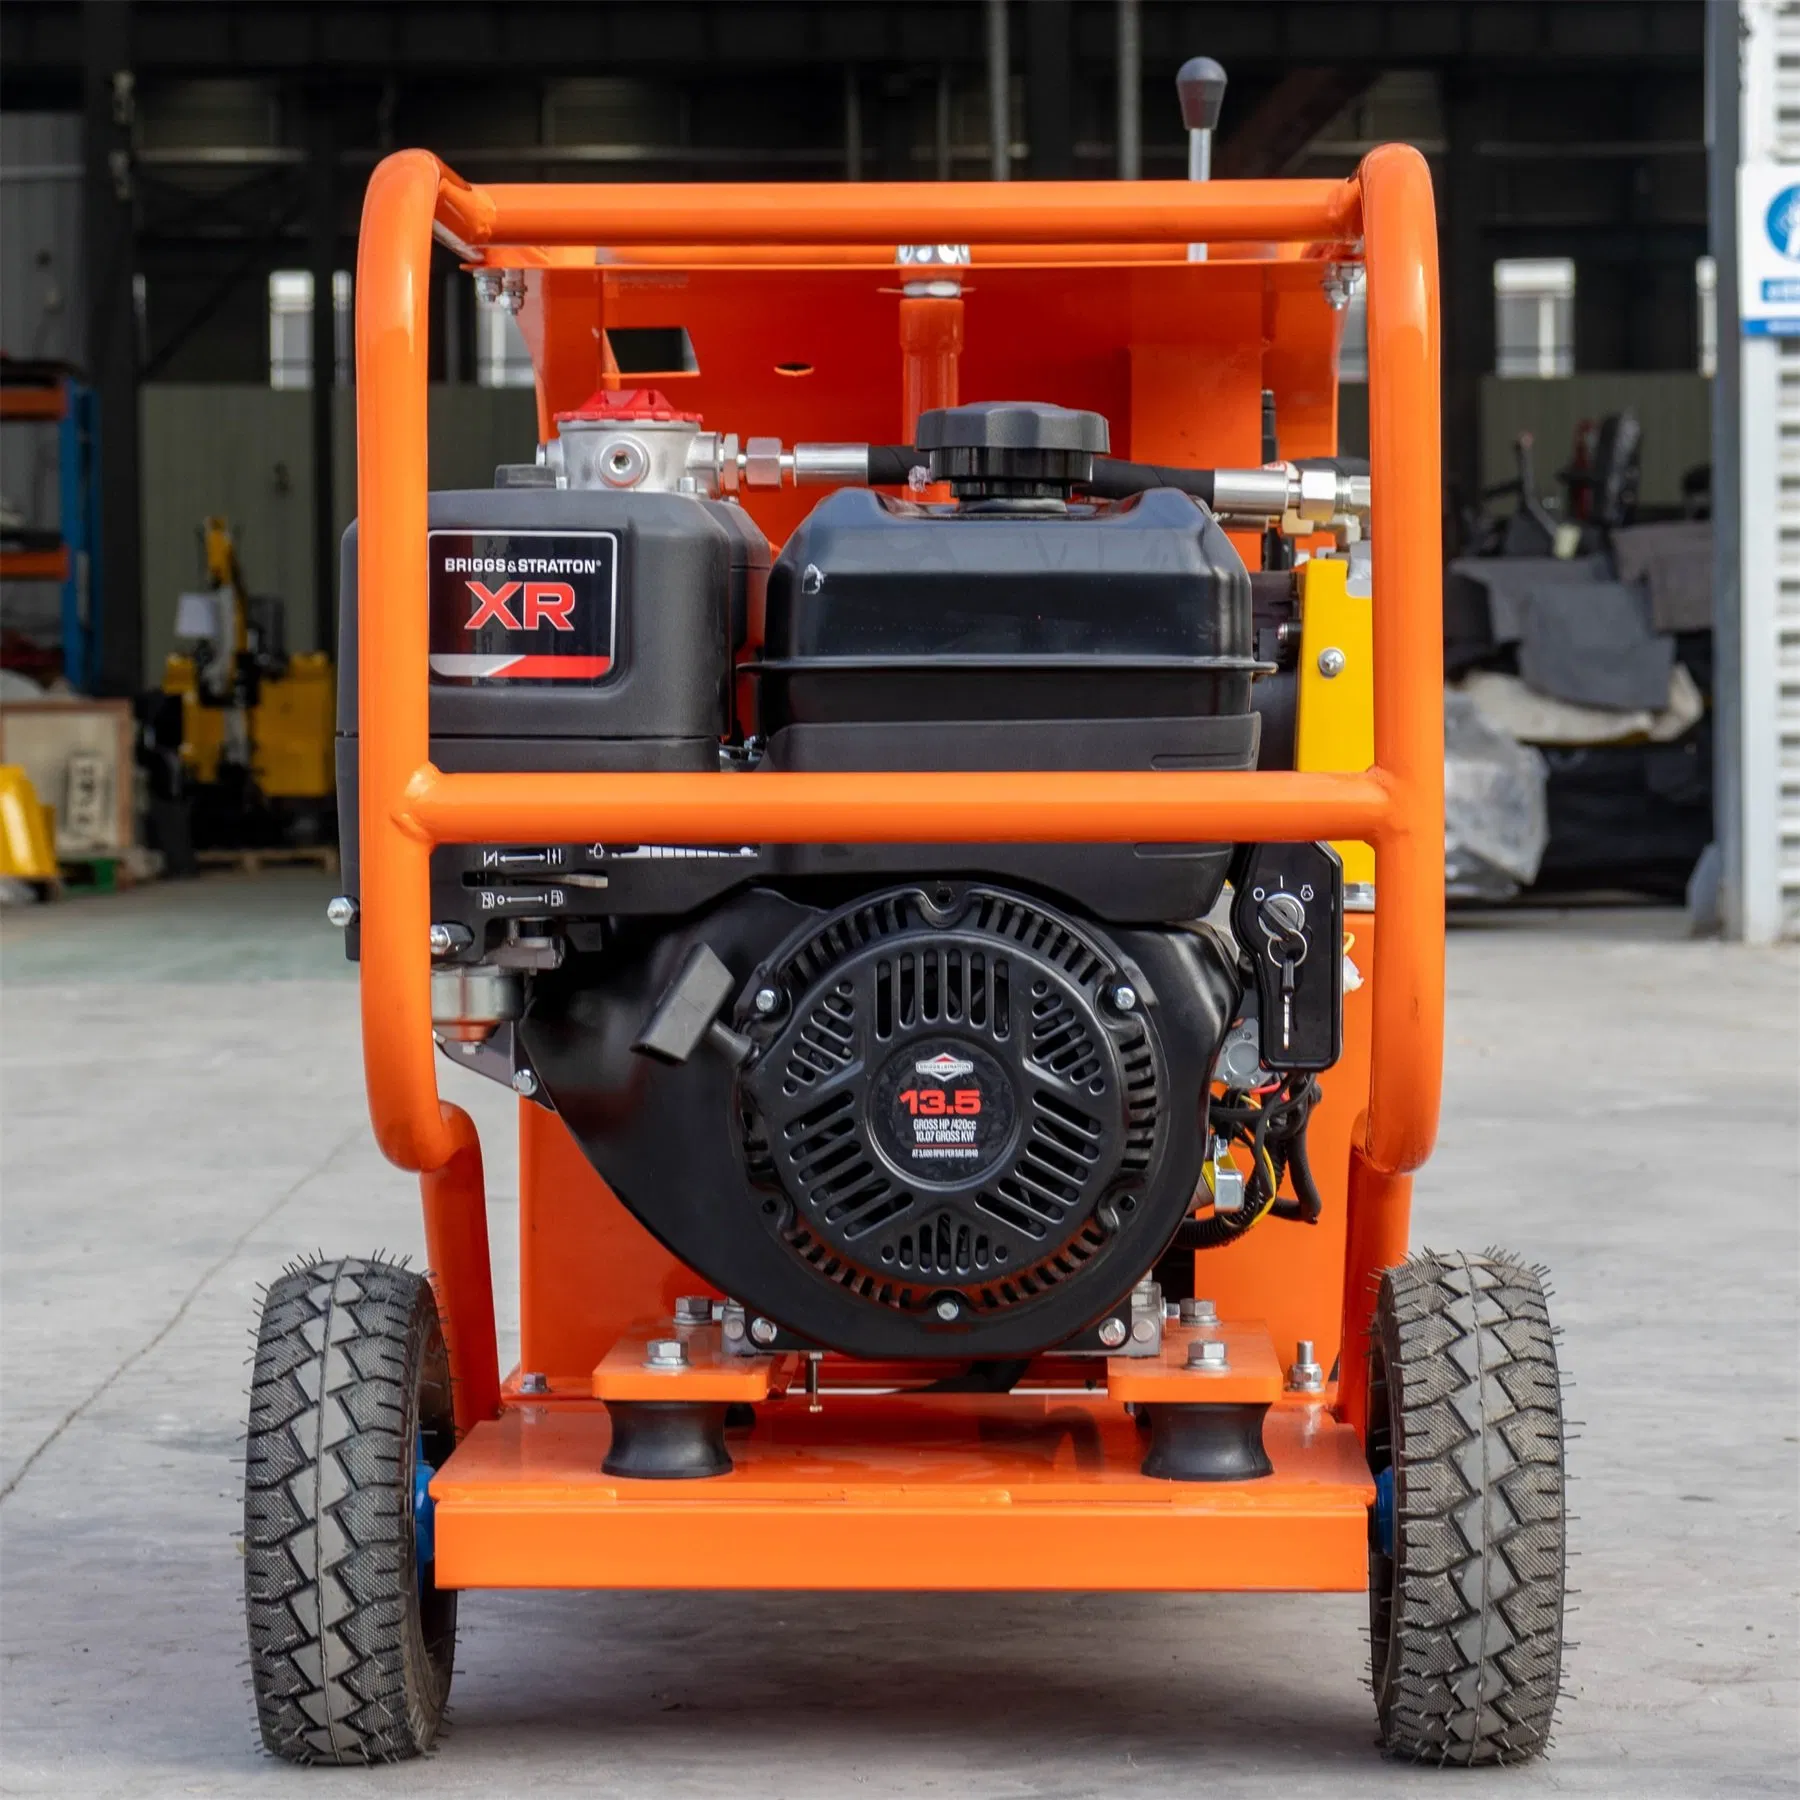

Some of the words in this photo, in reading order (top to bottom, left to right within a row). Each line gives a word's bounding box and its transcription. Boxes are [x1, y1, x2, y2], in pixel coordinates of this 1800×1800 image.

[464, 581, 576, 631] XR
[899, 1089, 981, 1115] 13.5
[913, 1118, 938, 1131] GROSS
[939, 1118, 950, 1131] HP
[916, 1130, 935, 1143] 10.07
[935, 1130, 960, 1143] GROSS
[961, 1130, 975, 1143] KW
